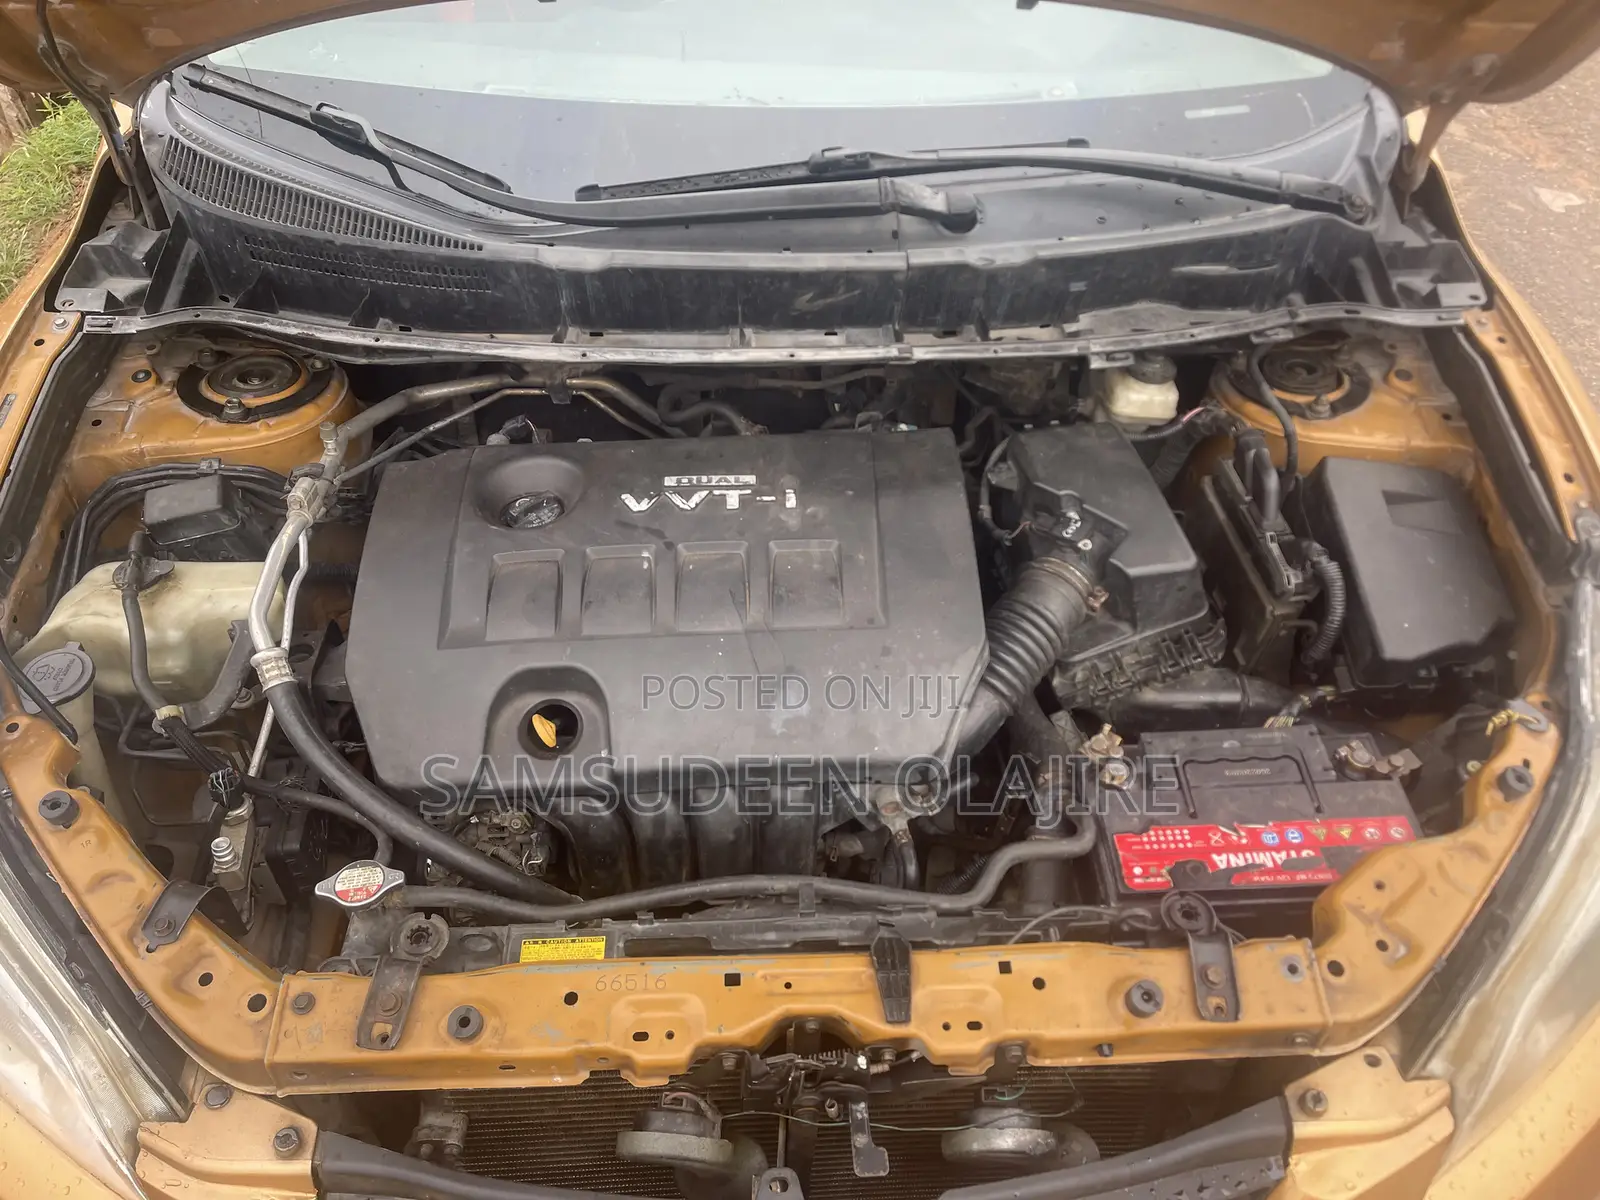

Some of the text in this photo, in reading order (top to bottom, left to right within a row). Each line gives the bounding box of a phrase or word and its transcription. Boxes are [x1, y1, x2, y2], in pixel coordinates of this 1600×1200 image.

[672, 476, 752, 486] DUAL
[620, 489, 797, 512] VVT-i
[595, 973, 667, 992] 66516
